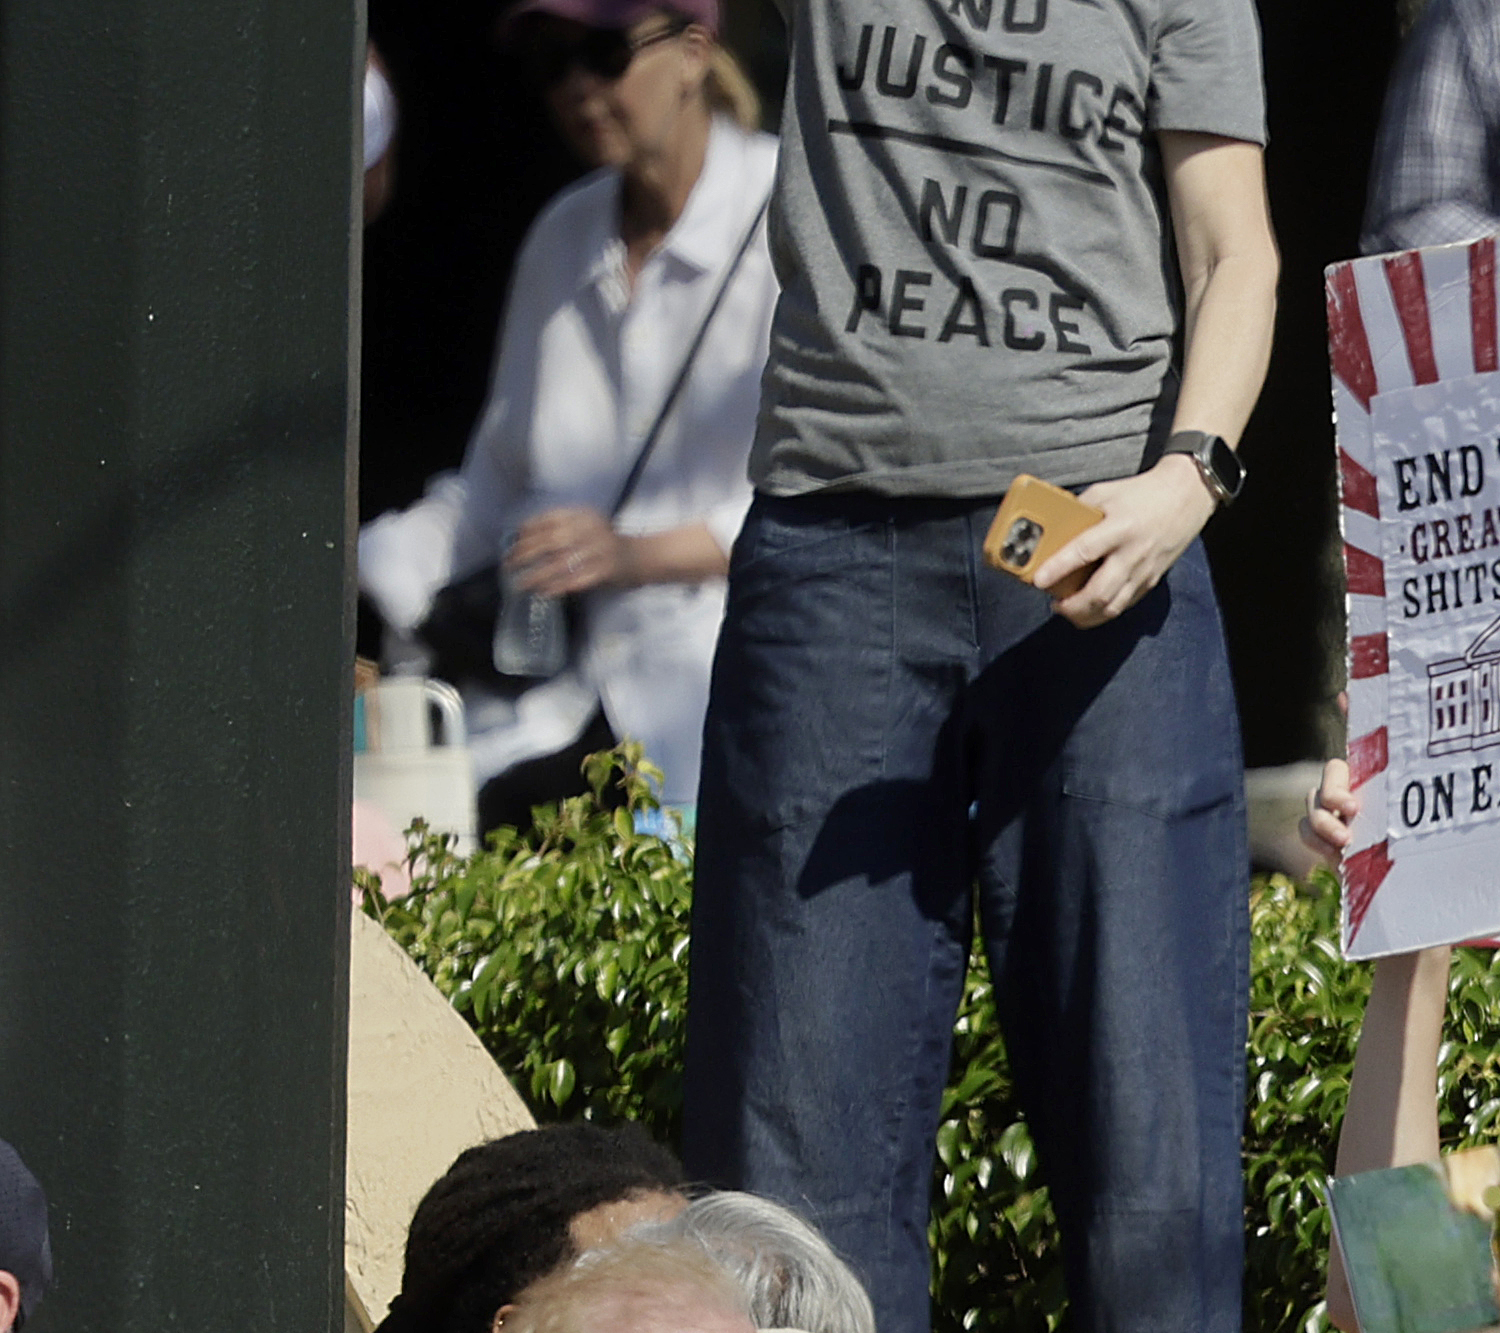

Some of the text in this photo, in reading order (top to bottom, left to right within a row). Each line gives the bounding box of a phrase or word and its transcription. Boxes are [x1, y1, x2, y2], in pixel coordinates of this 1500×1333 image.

[838, 25, 1146, 152] JUSTICE
[918, 178, 1022, 259] NO
[845, 263, 1092, 355] PEACE
[1392, 444, 1485, 512] END
[1401, 772, 1454, 828] ON
